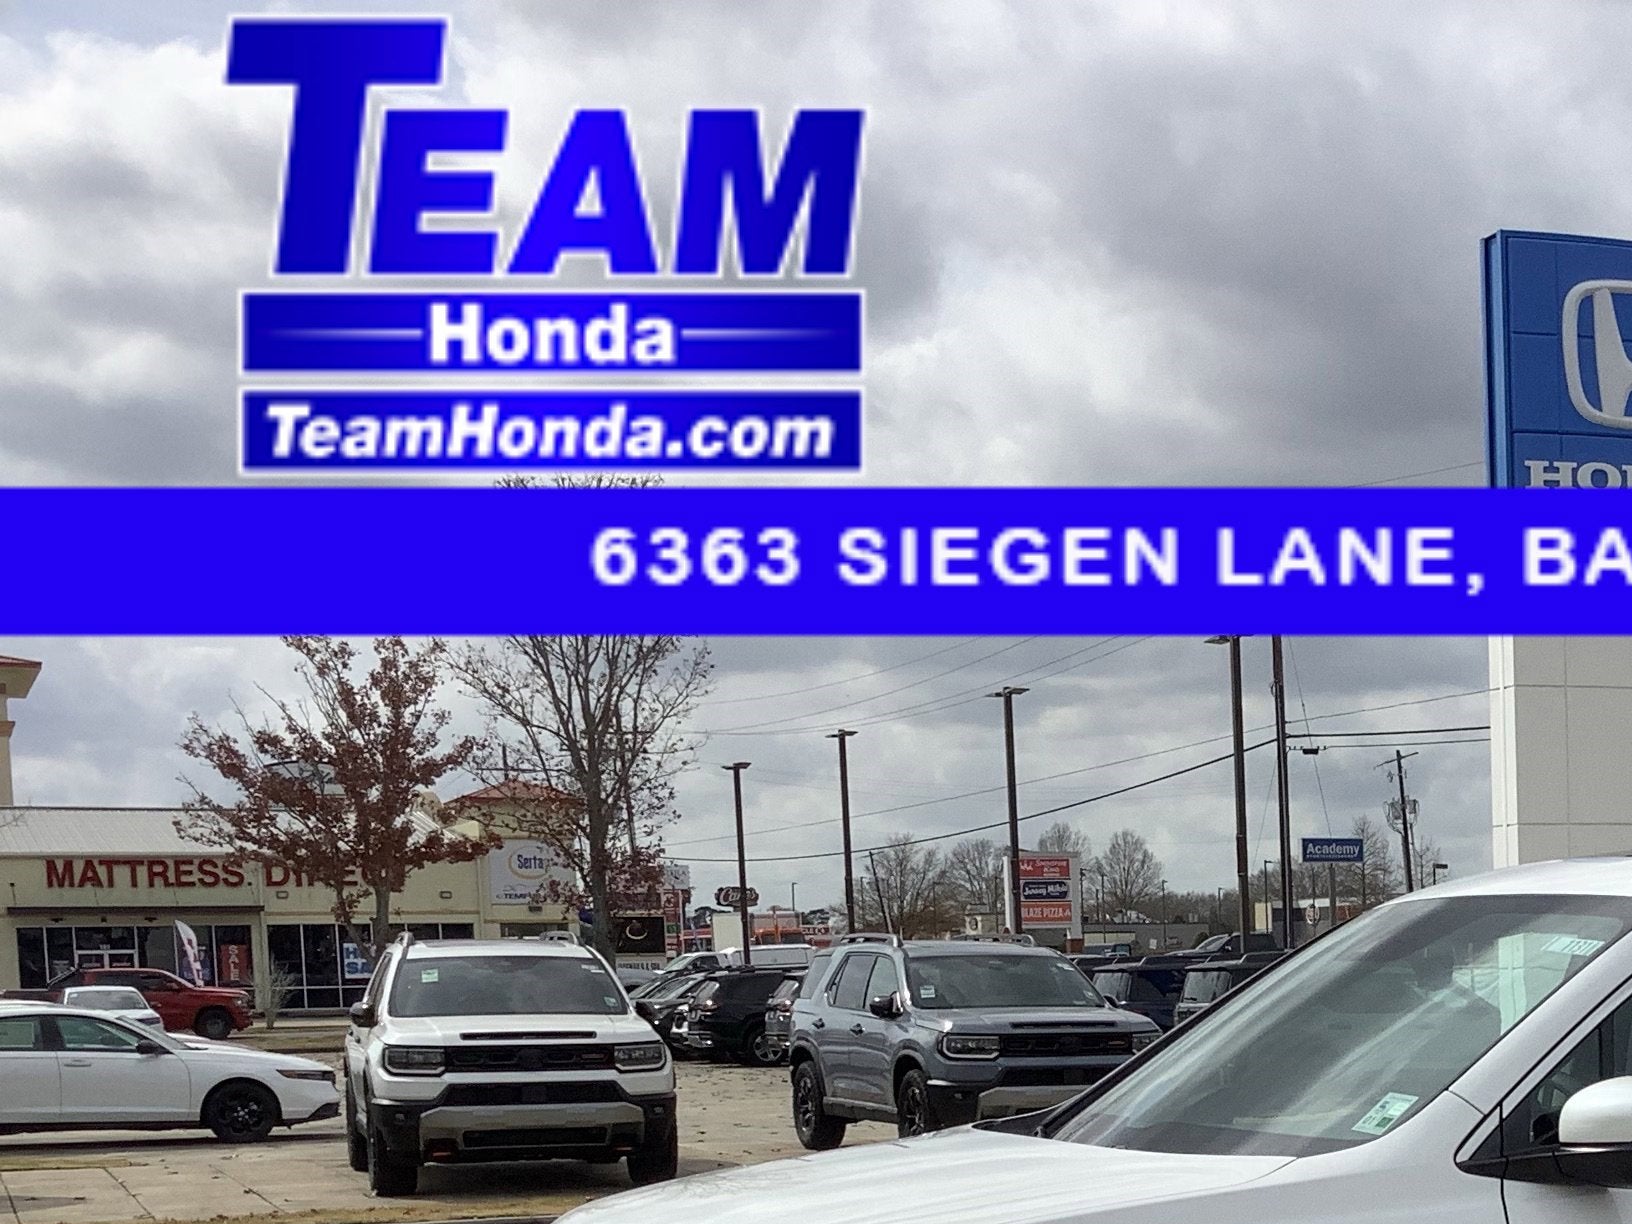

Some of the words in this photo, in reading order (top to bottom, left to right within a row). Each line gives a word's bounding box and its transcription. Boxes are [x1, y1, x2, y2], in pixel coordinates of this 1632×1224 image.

[1306, 843, 1360, 857] Academy
[516, 854, 545, 869] Serta
[45, 858, 245, 888] MATTRESS
